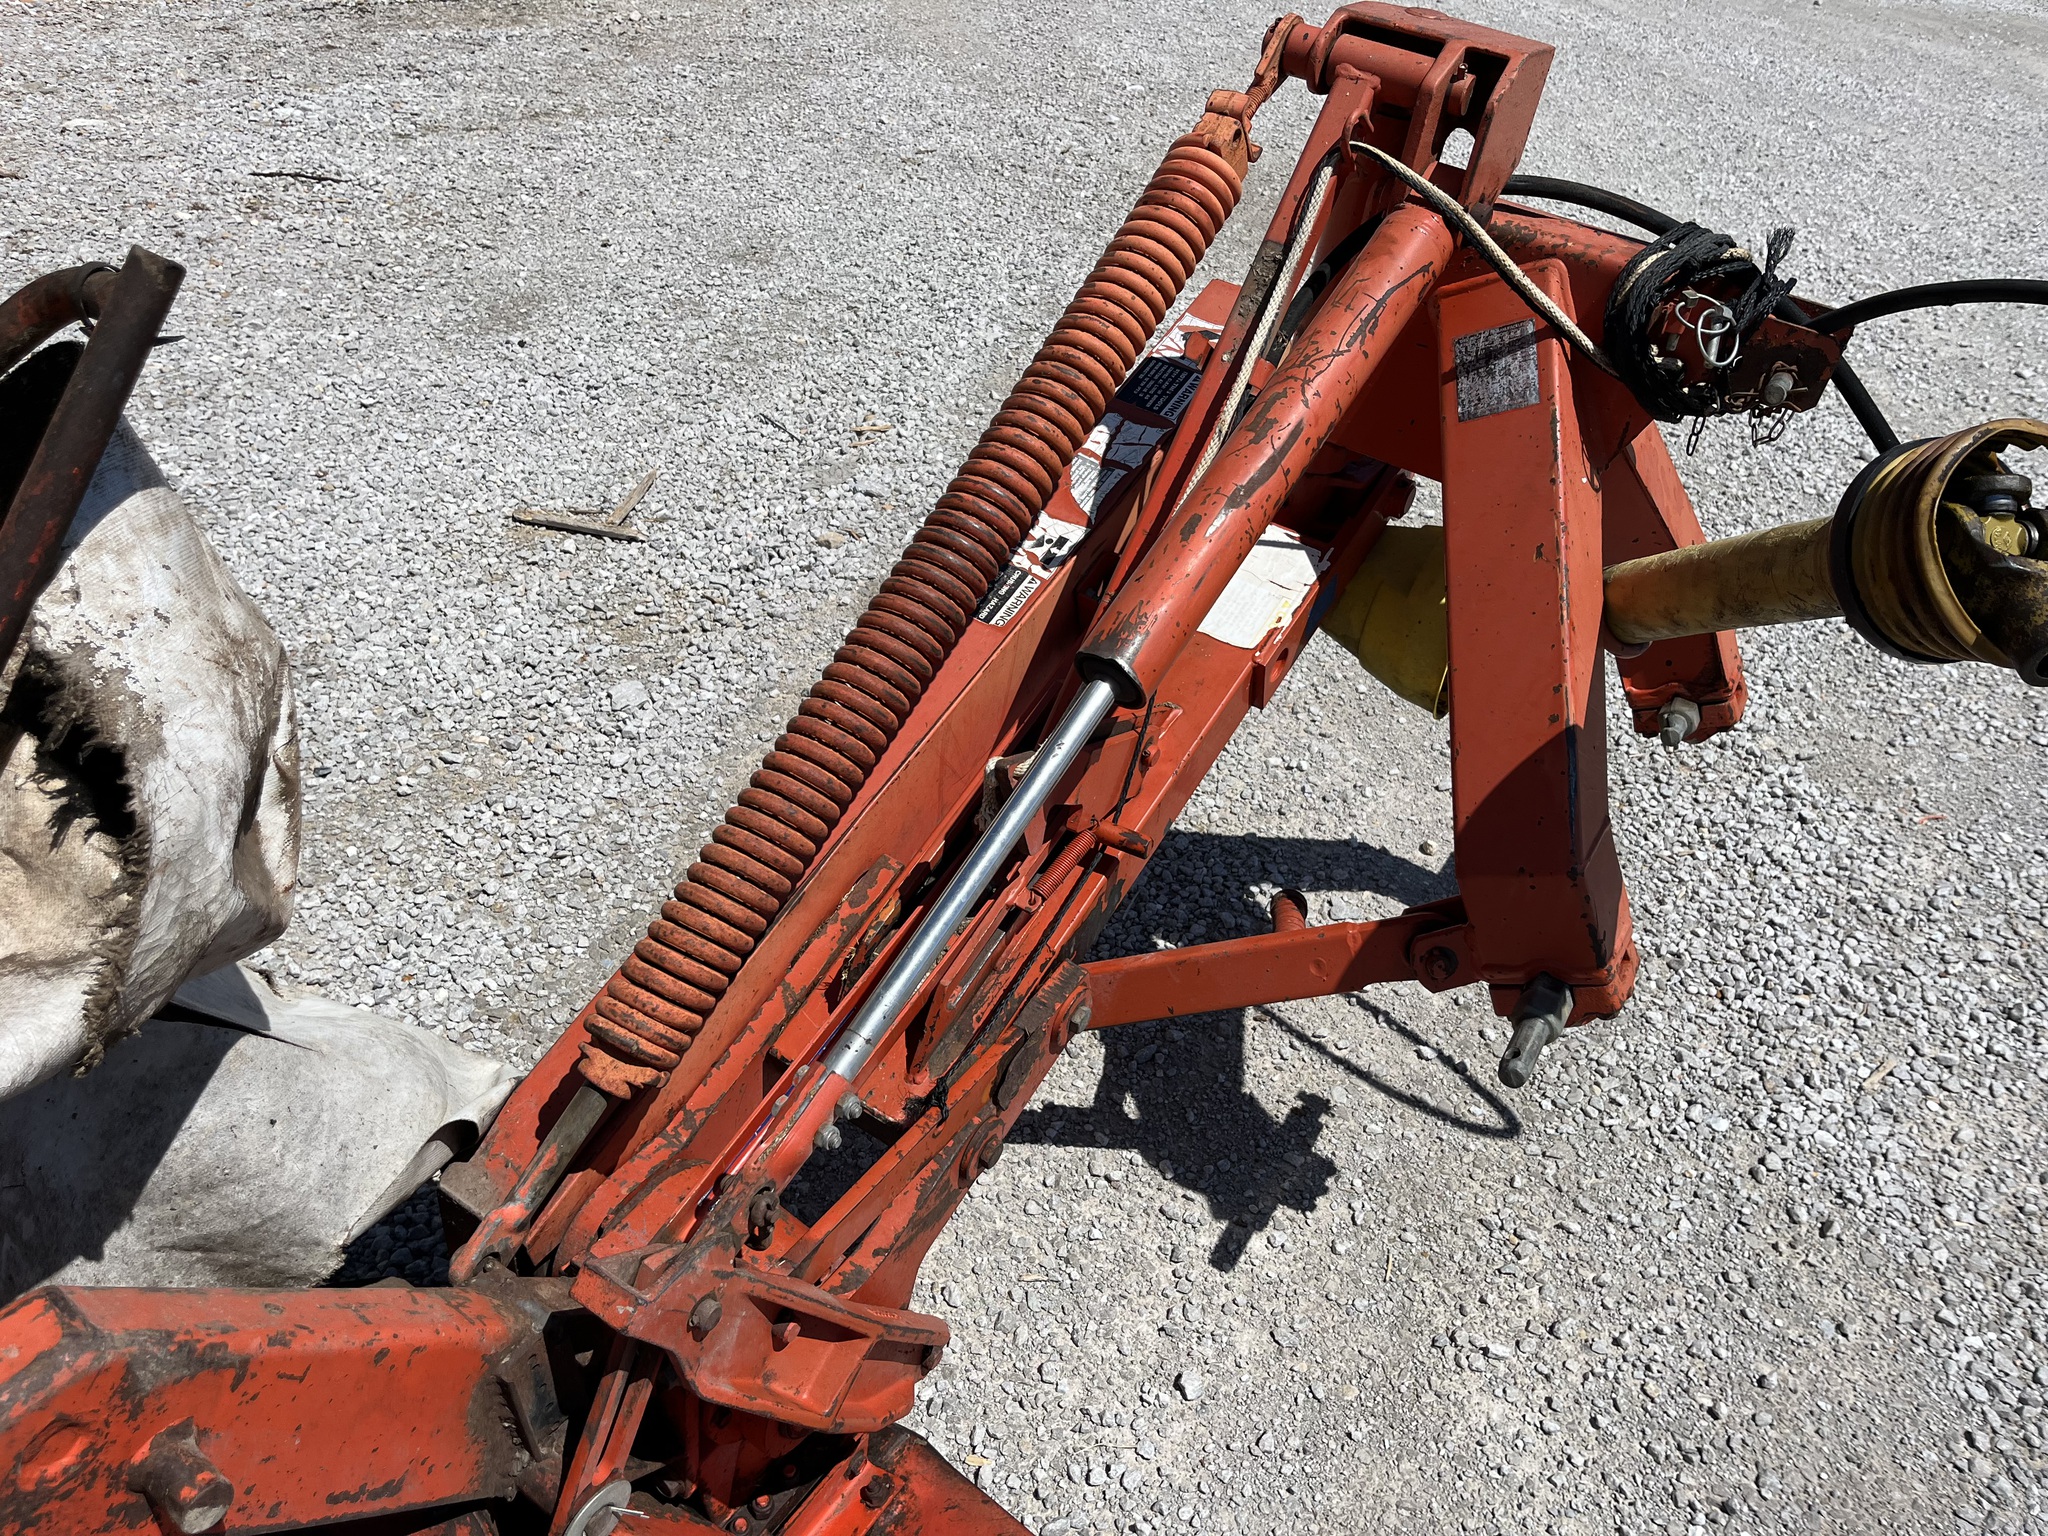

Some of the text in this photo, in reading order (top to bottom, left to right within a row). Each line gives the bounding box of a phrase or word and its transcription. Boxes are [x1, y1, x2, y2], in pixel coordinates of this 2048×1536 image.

[1151, 393, 1169, 411] TOOLS
[1162, 381, 1199, 418] WARNING
[978, 598, 998, 619] HAZARD
[994, 585, 1034, 627] WARNING
